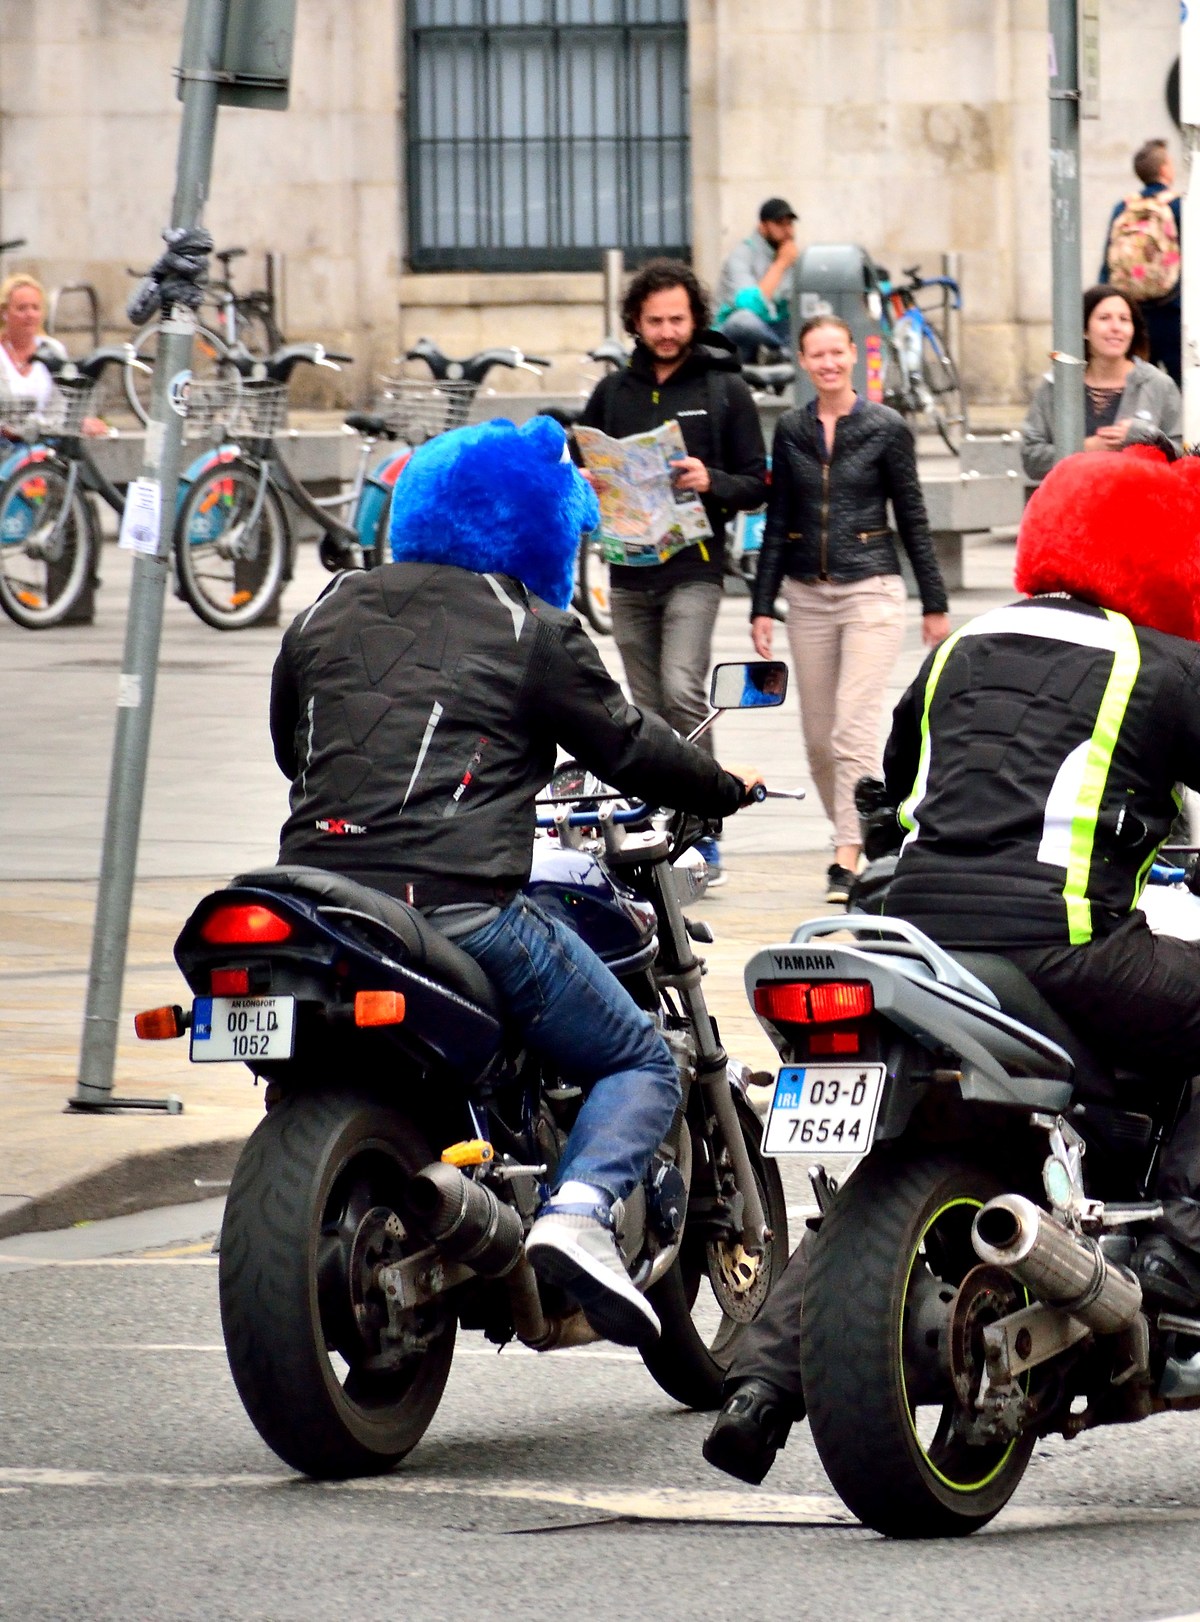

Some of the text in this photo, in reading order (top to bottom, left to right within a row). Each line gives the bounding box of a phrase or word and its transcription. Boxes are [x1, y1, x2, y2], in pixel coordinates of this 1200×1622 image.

[774, 955, 836, 971] YAMAHA
[227, 1011, 277, 1032] 00-LD
[233, 1035, 270, 1056] 1052
[777, 1092, 799, 1107] IRL
[810, 1080, 867, 1106] 03-D
[788, 1119, 861, 1143] 76544
